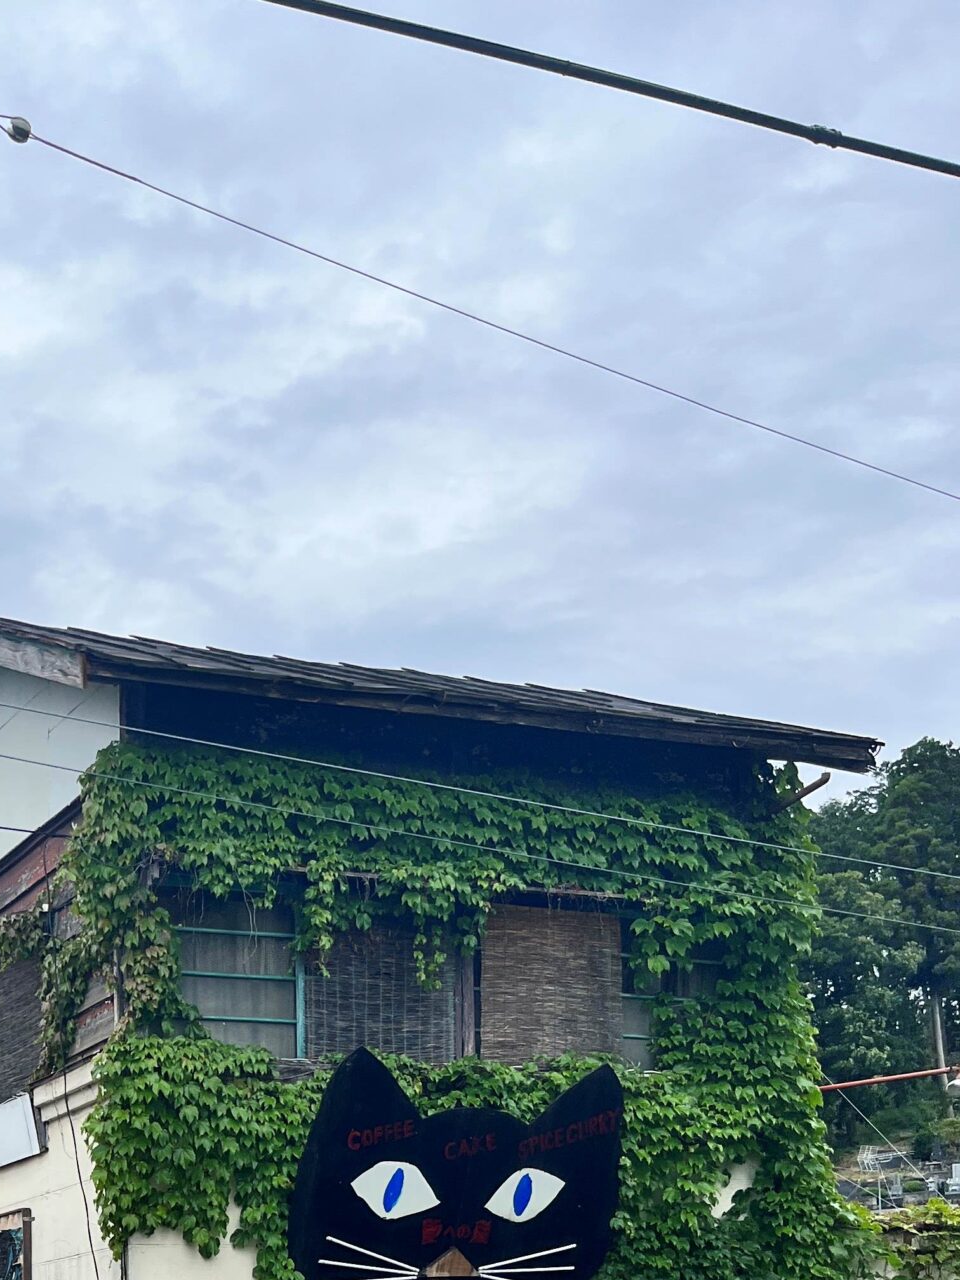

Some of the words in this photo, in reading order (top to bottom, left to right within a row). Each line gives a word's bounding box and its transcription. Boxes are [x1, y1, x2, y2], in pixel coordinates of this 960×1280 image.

[346, 1119, 415, 1151] COFFEE
[443, 1134, 497, 1161] CAKE
[517, 1127, 565, 1159] SPICE
[565, 1110, 620, 1143] CURRY
